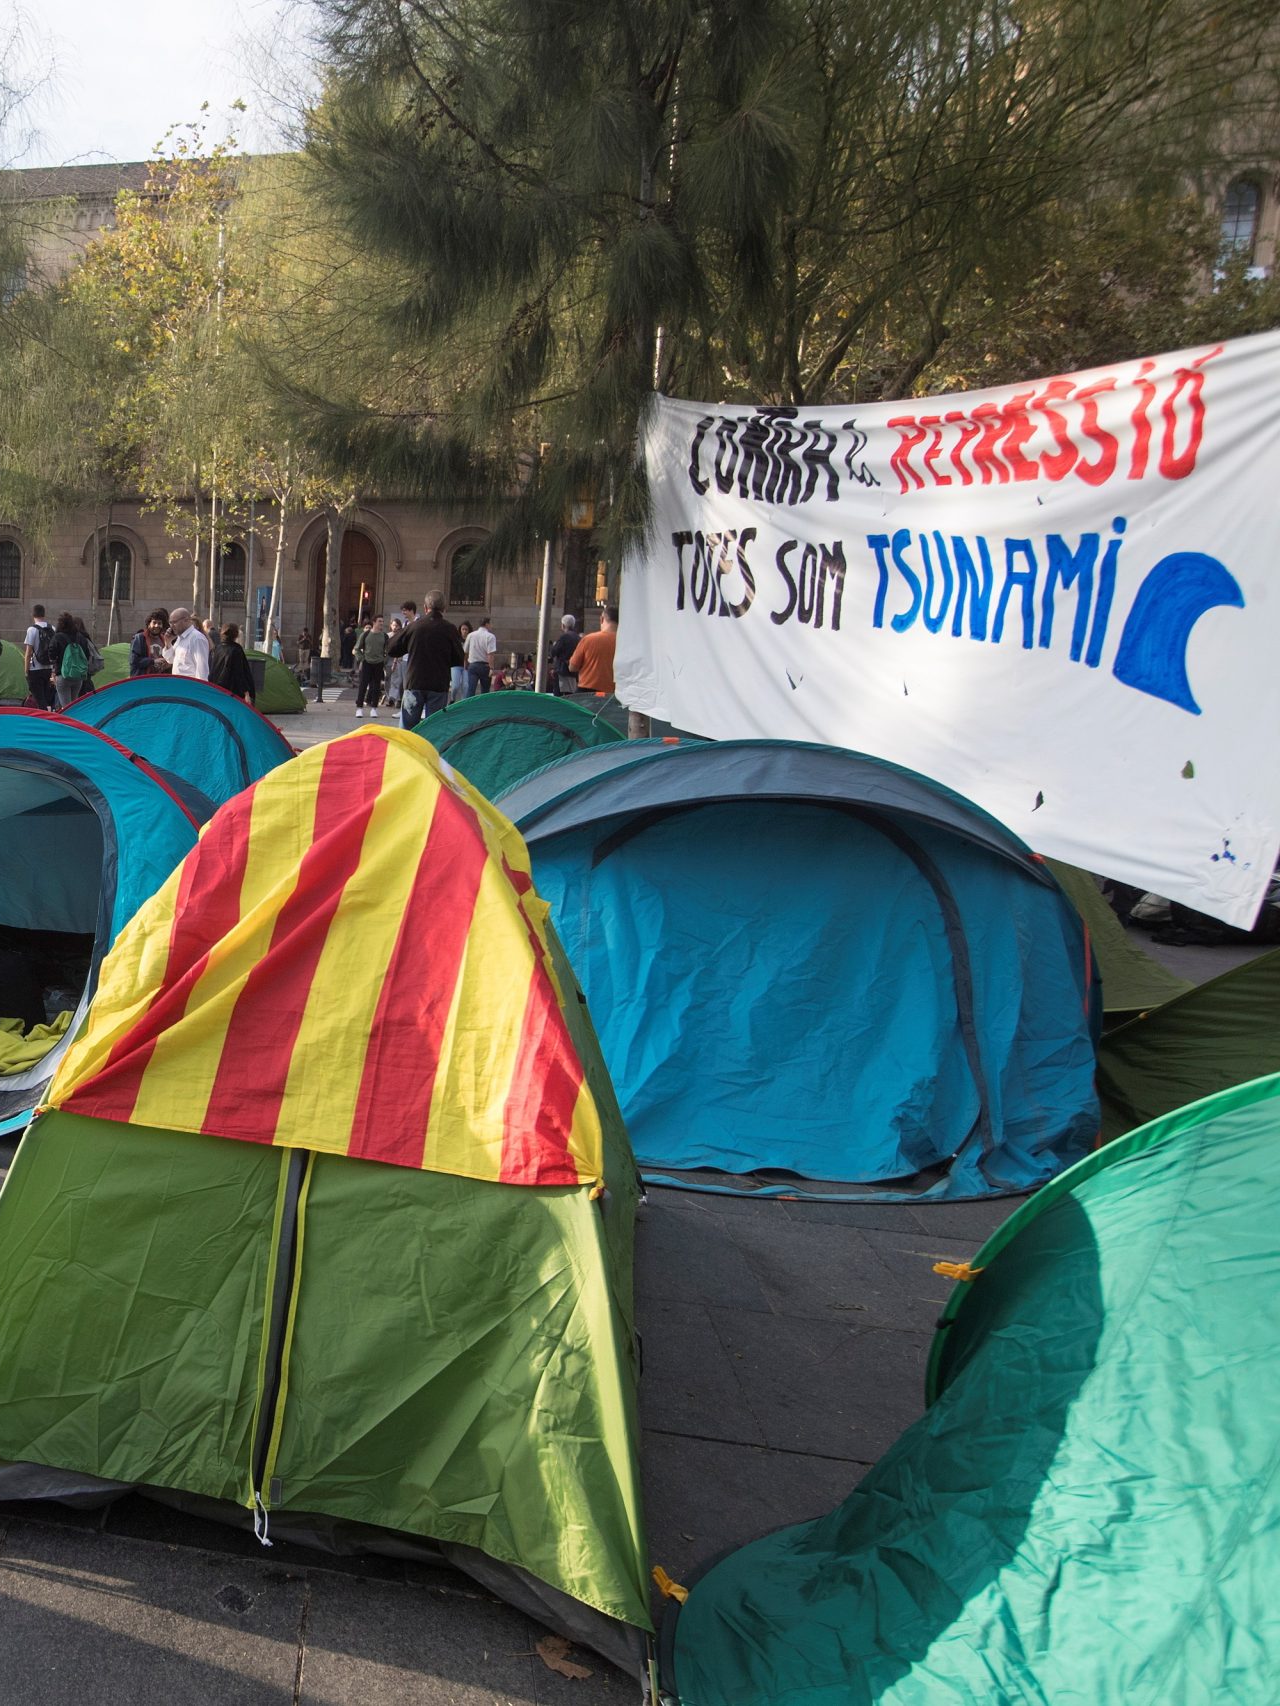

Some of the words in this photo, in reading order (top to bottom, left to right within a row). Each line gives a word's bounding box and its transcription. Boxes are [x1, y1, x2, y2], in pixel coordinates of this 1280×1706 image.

[689, 407, 839, 506] CONTRA
[671, 527, 757, 618] TOTES
[770, 539, 846, 631] SOM
